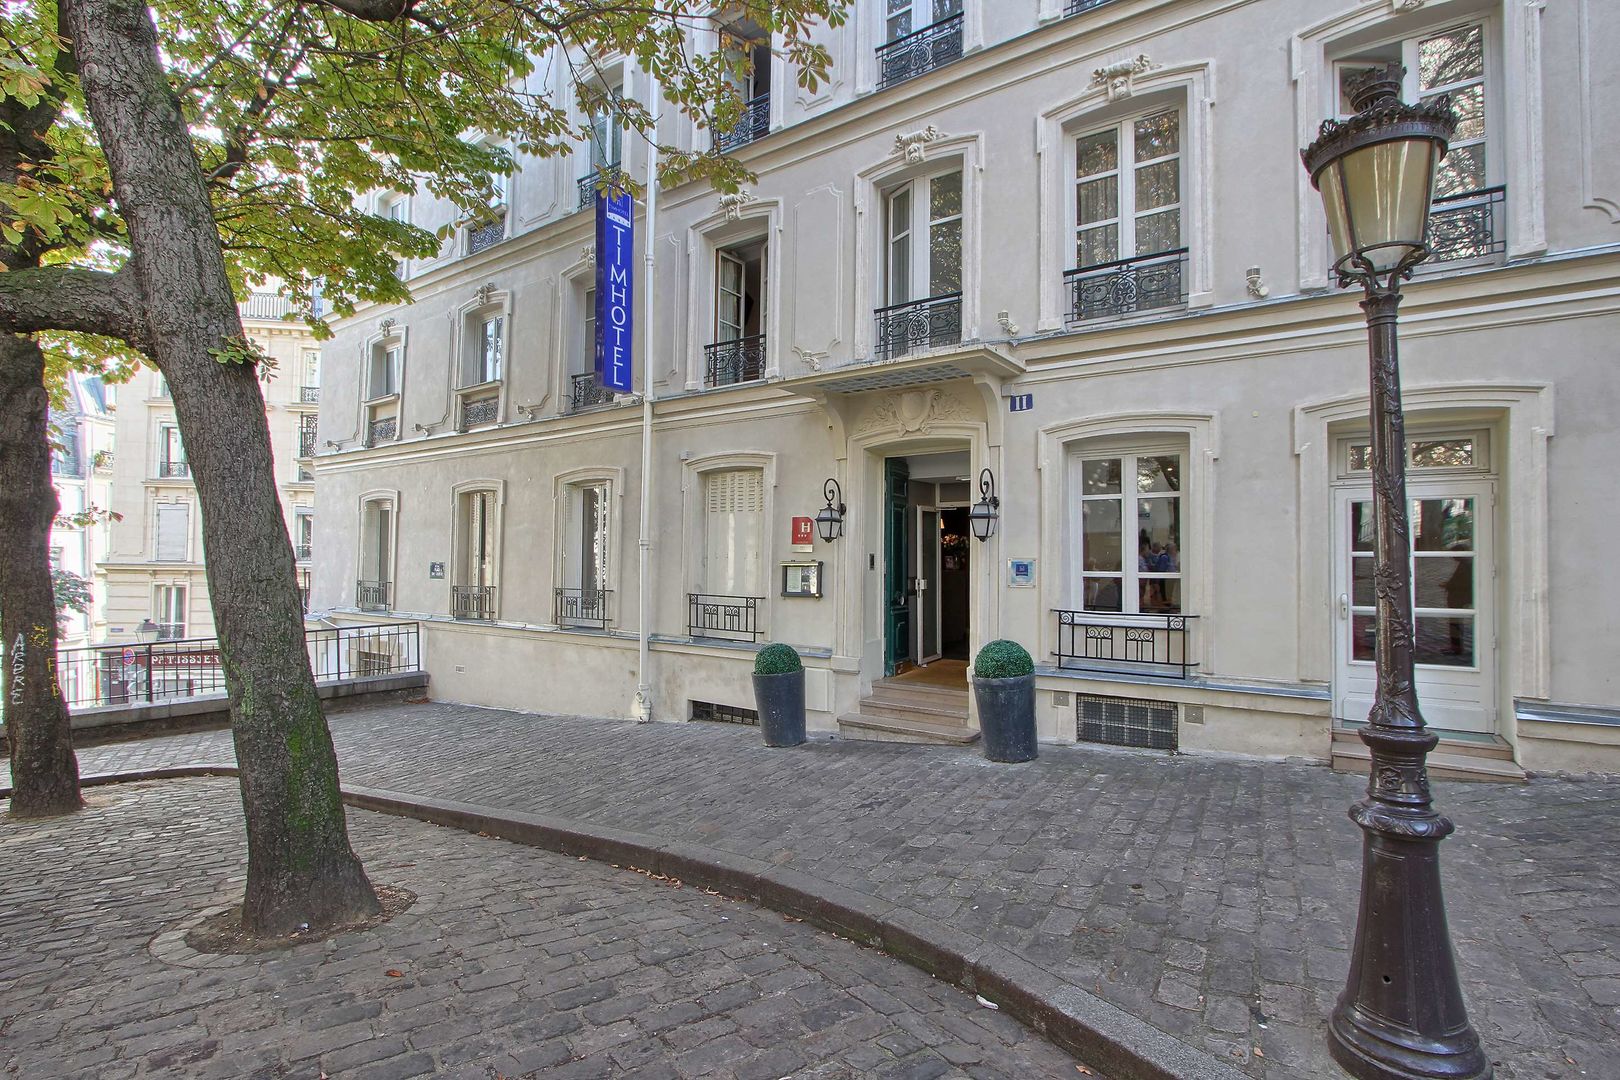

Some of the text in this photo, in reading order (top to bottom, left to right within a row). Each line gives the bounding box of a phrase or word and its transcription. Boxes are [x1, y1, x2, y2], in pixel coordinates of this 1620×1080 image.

[610, 225, 627, 386] TIMHOTEL
[1015, 396, 1027, 410] 11
[801, 522, 811, 533] H
